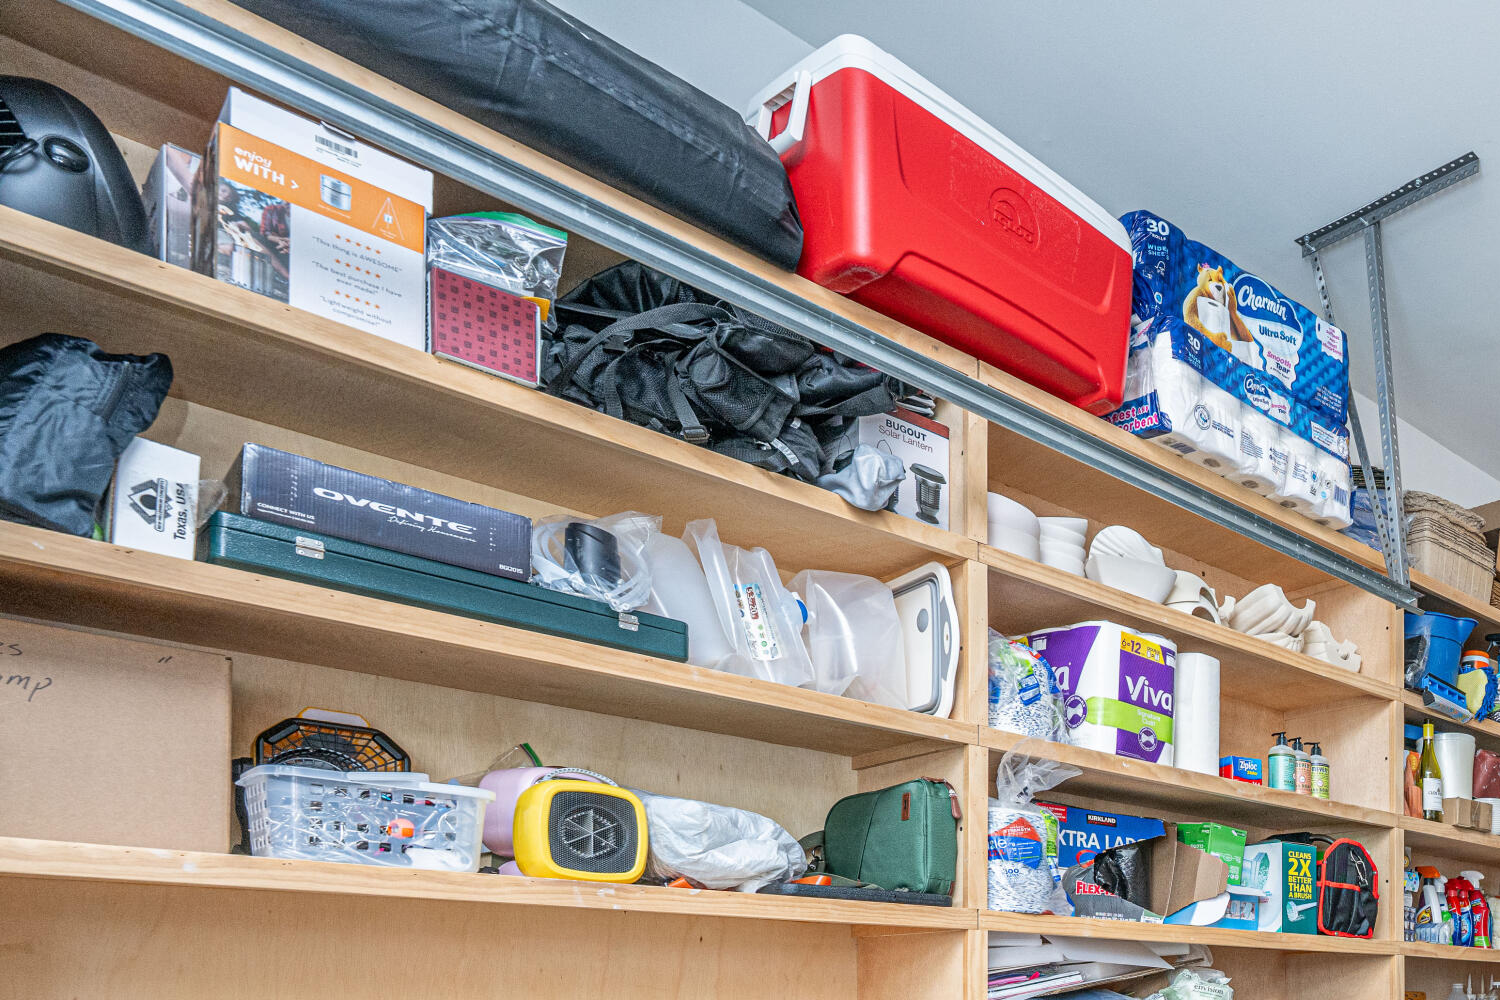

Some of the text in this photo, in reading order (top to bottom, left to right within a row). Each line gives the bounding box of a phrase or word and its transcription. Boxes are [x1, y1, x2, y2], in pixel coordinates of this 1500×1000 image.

[234, 147, 273, 168] enjoy
[233, 155, 285, 186] WITH
[1146, 219, 1170, 236] 30
[1238, 285, 1287, 320] Charmin
[1187, 332, 1200, 350] 30
[1258, 325, 1297, 346] Ultra Soft
[1266, 351, 1292, 369] Smooth
[1276, 362, 1291, 374] Tear
[879, 425, 933, 453] Solar Lantern
[885, 419, 927, 441] BUGOUT
[257, 502, 288, 514] CONNECT
[289, 509, 305, 518] WITH
[313, 487, 473, 535] OVENTE
[172, 509, 188, 541] Texas,
[1125, 675, 1172, 712] Viva
[1137, 709, 1161, 722] Signature
[1141, 717, 1156, 727] Cloth
[1239, 760, 1258, 772] Ziploc
[1087, 814, 1116, 824] KIRKLAND
[1057, 829, 1100, 849] XTRA
[1288, 850, 1312, 860] CLEANS
[1288, 858, 1312, 878] 2X
[1288, 876, 1313, 885] BETTER
[1288, 883, 1312, 894] THAN
[1293, 892, 1312, 900] BRUSH
[1193, 984, 1224, 995] envision
